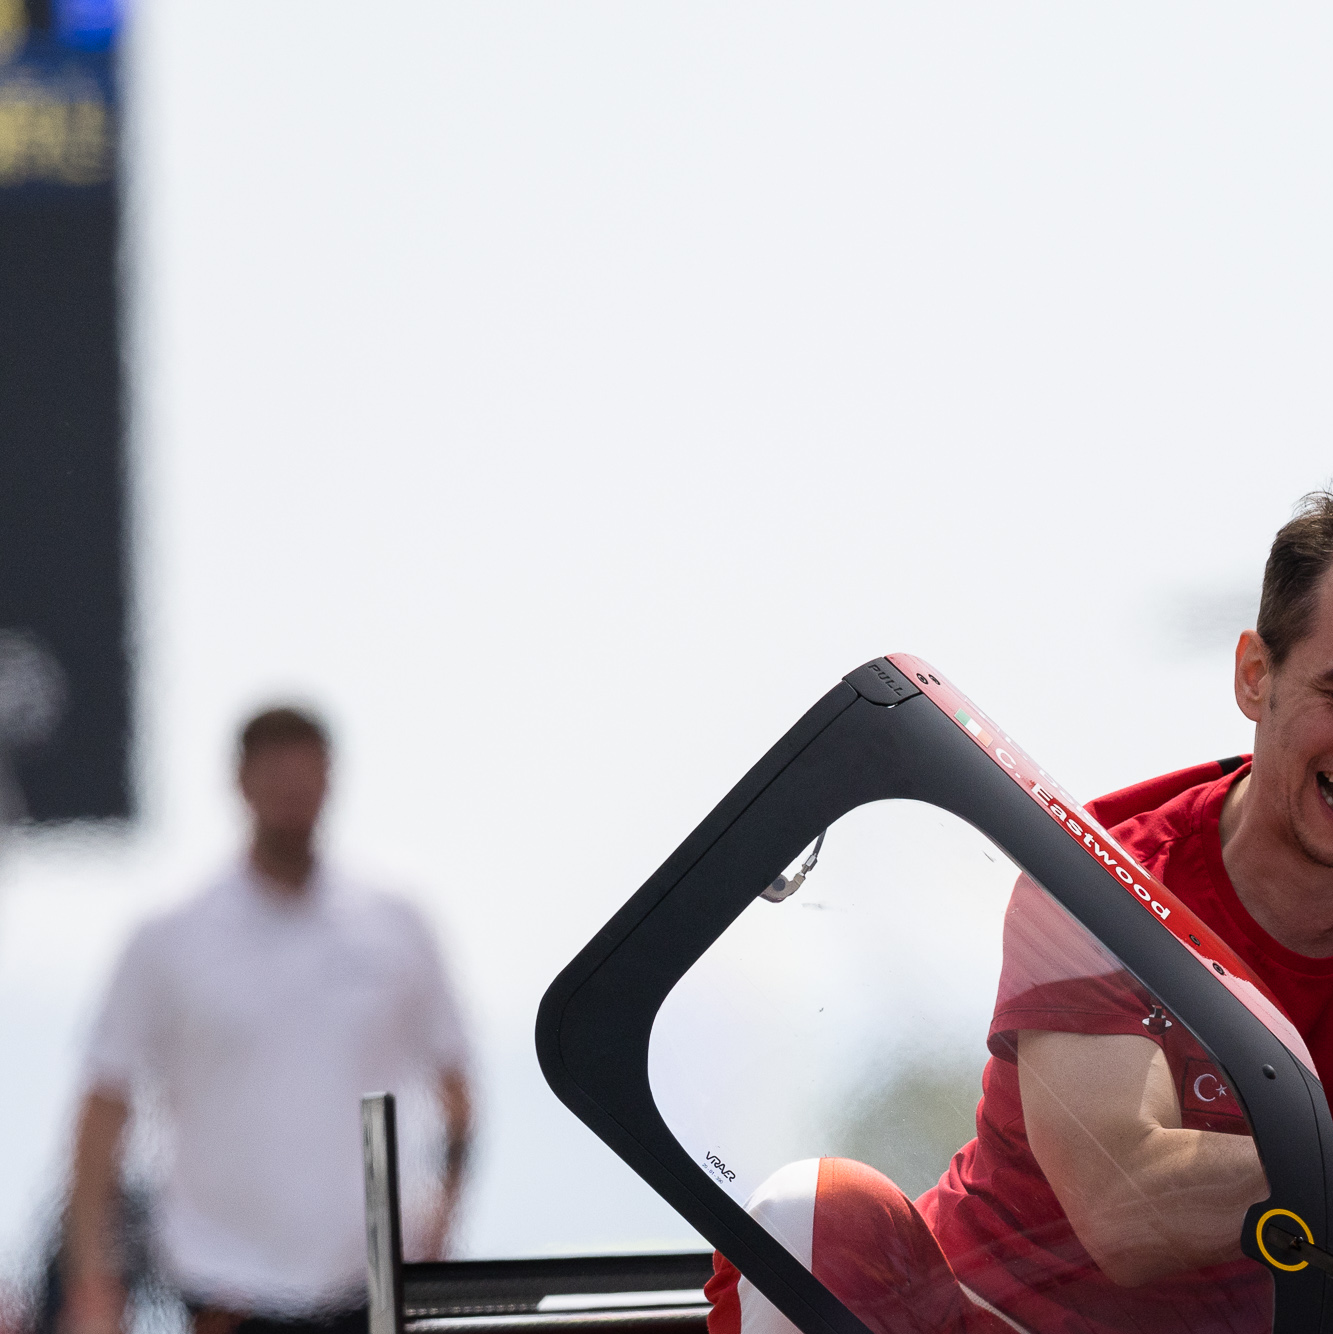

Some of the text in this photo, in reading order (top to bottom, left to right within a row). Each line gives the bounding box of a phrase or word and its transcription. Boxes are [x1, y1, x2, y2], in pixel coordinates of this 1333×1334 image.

[867, 663, 903, 697] PULL
[994, 747, 1171, 921] C. Eastwood
